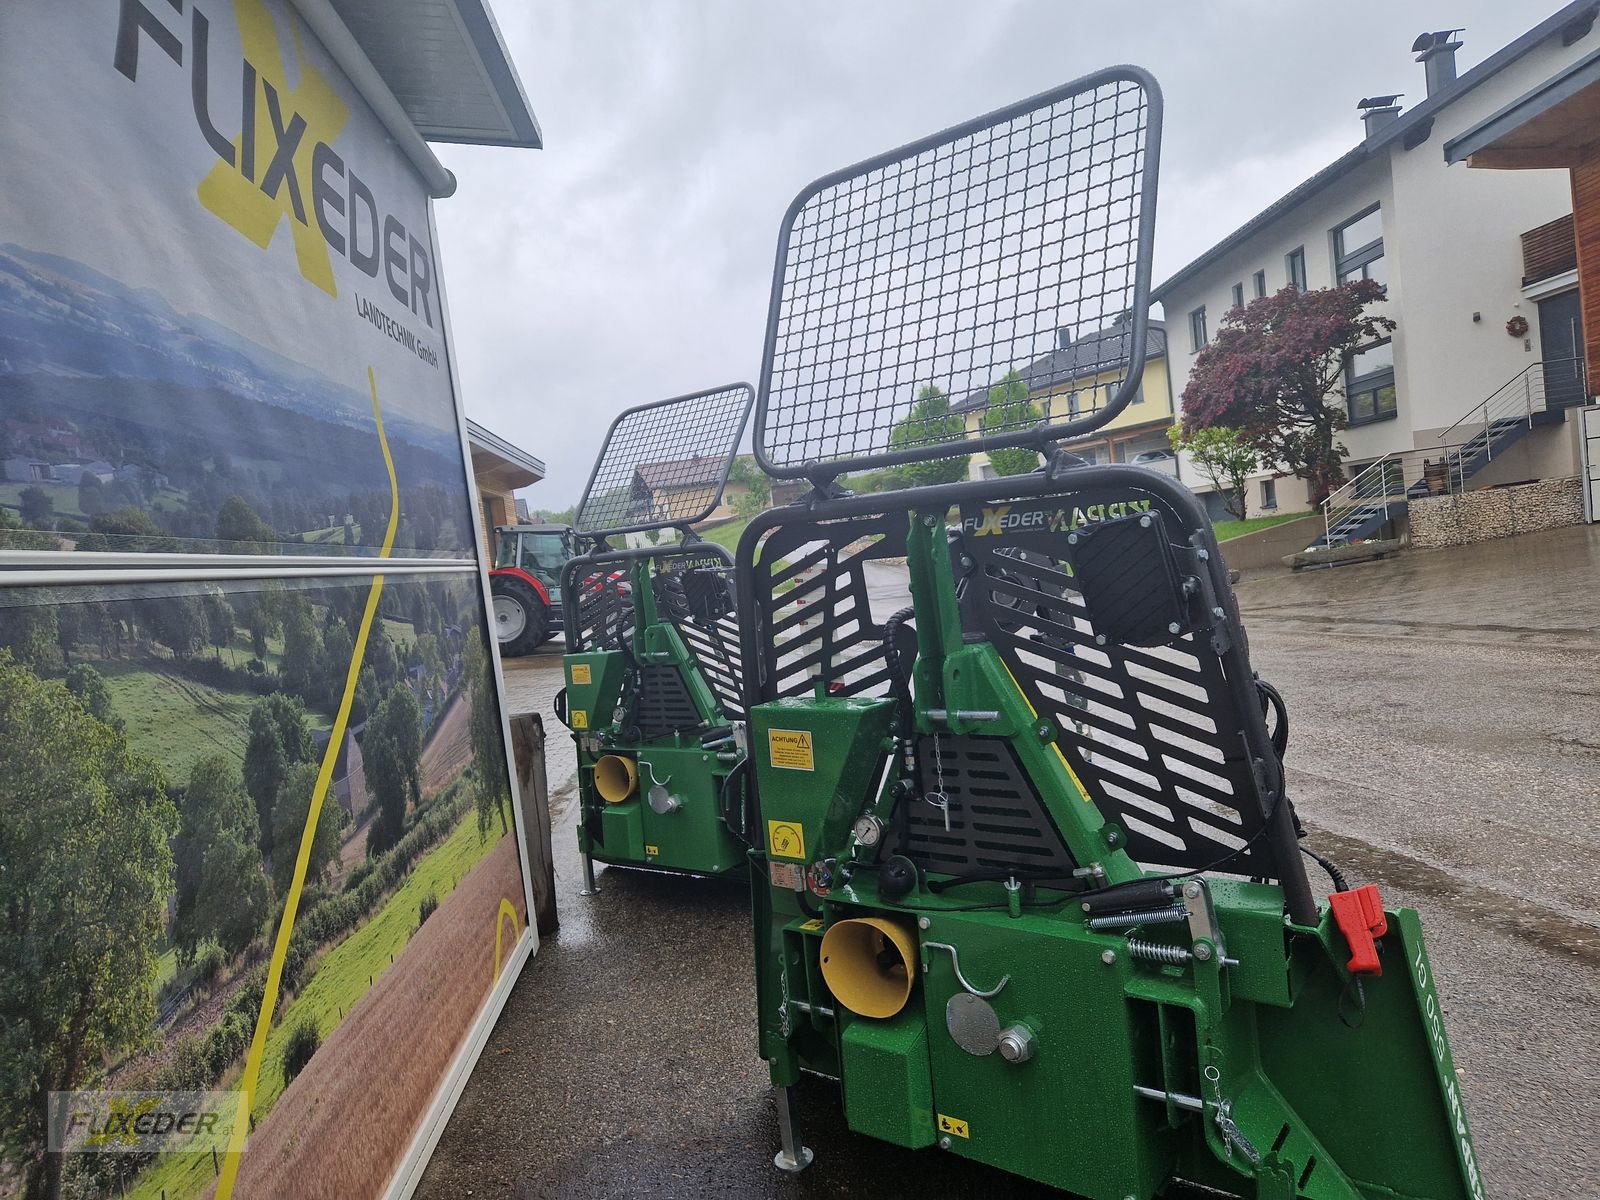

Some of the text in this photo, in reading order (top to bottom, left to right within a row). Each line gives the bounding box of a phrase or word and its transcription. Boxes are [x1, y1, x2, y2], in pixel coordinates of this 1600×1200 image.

[355, 292, 438, 370] LANDTECHNIK GmbH
[964, 506, 1044, 536] FUXEDER
[1415, 941, 1426, 988] GL
[1426, 994, 1444, 1062] 550
